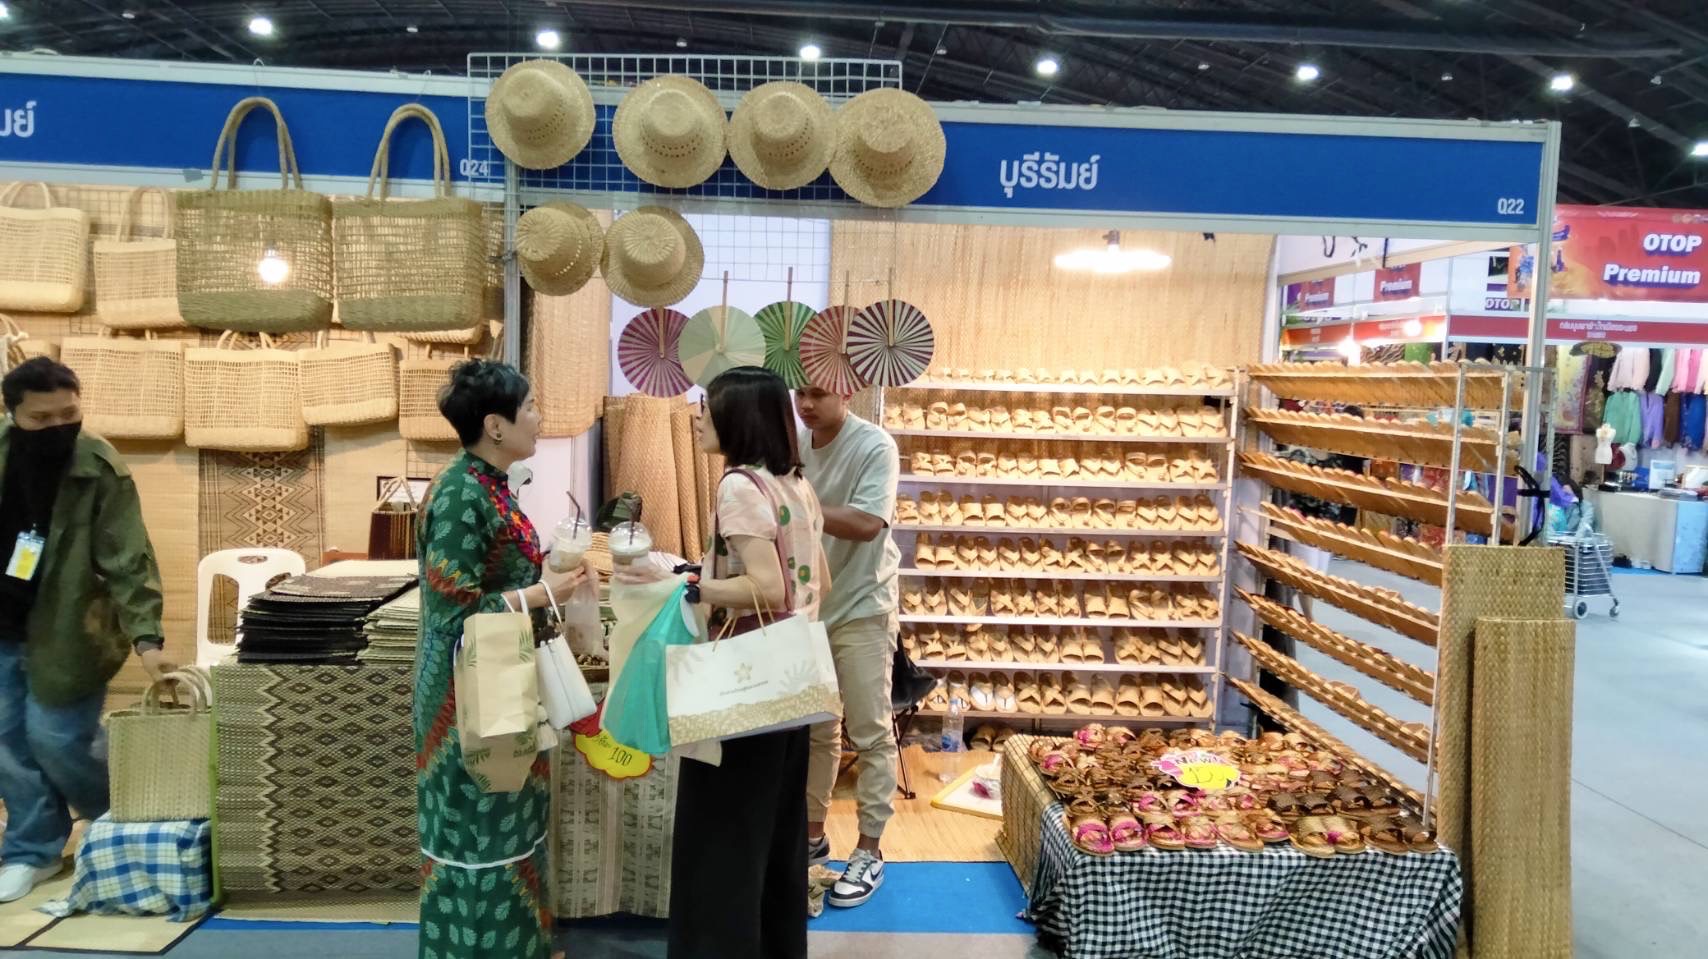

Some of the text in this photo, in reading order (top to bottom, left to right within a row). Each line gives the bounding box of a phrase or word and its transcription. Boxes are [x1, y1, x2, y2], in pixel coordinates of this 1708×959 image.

[1000, 151, 1101, 199] บุรีรัมย์
[1497, 198, 1525, 215] Q22
[1643, 233, 1703, 254] OTOP
[1603, 263, 1701, 286] Premium
[609, 746, 633, 767] 100
